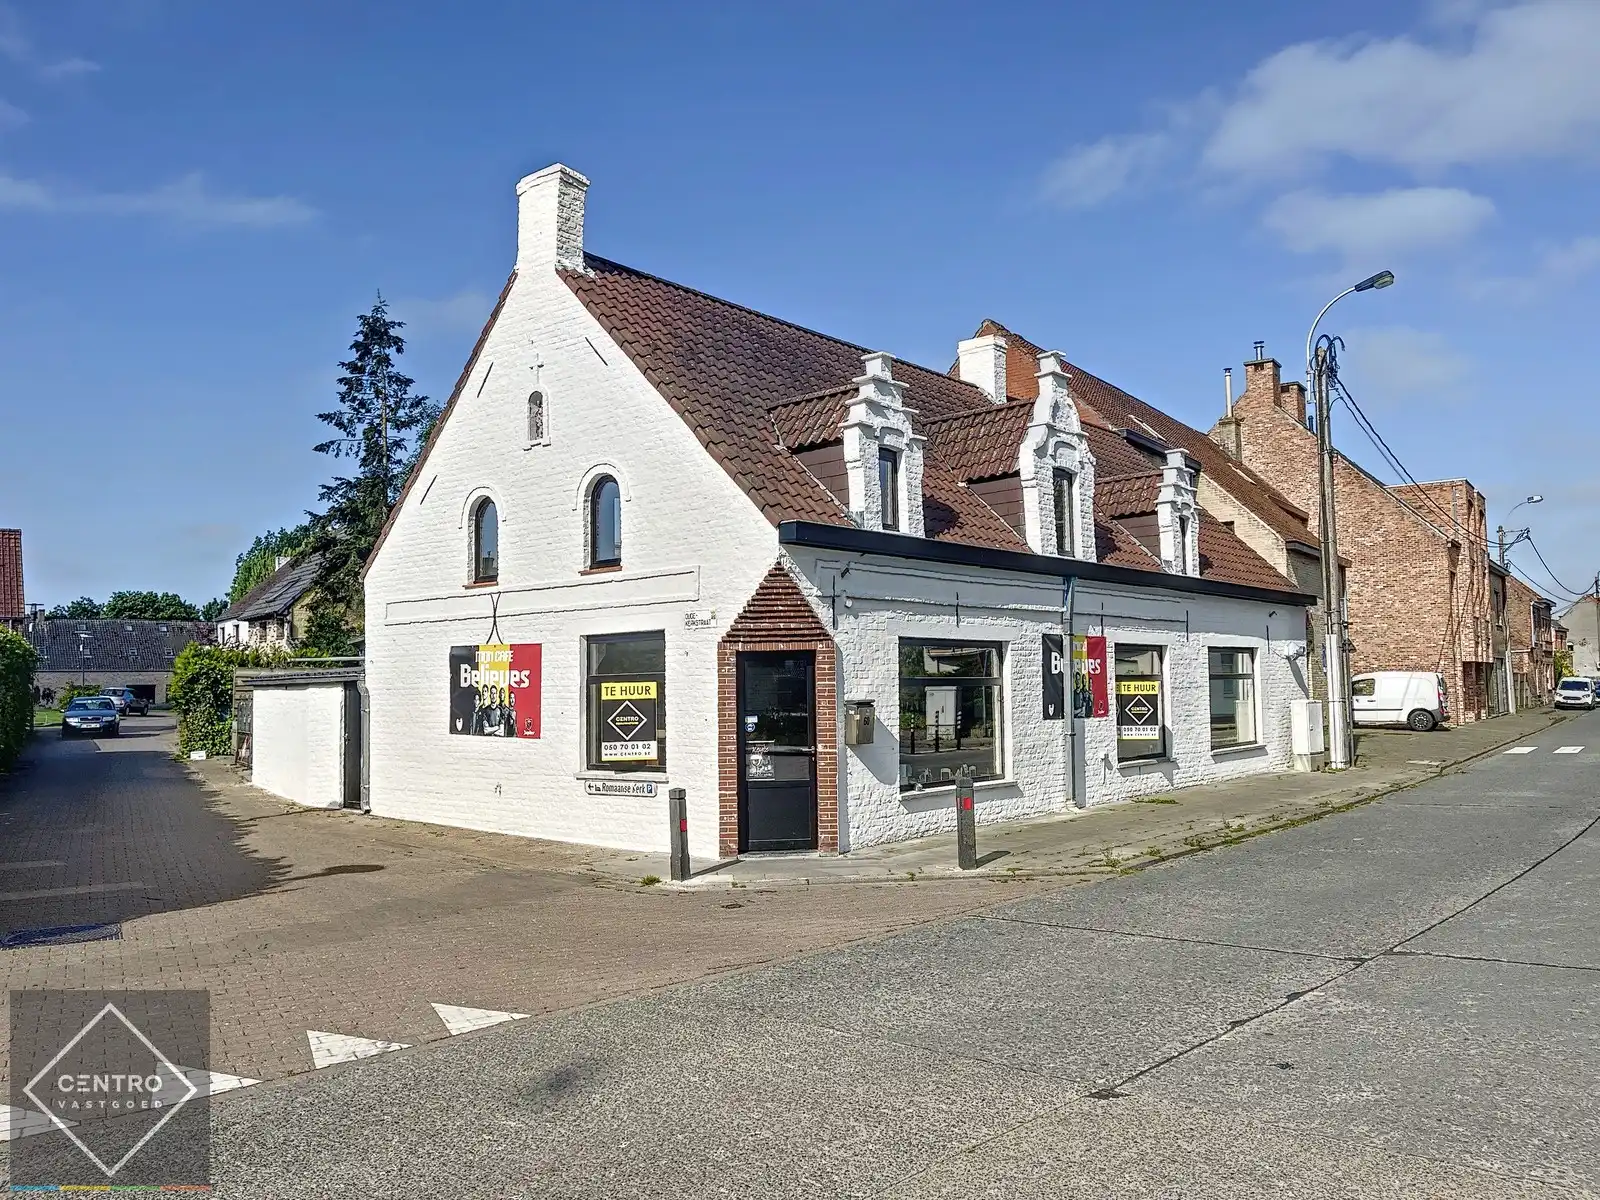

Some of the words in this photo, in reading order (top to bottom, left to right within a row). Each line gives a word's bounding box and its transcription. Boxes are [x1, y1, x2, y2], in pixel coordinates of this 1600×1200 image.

[460, 663, 530, 688] Believes
[604, 686, 616, 696] TE
[620, 685, 651, 696] HUUR
[602, 782, 631, 793] Romaanse
